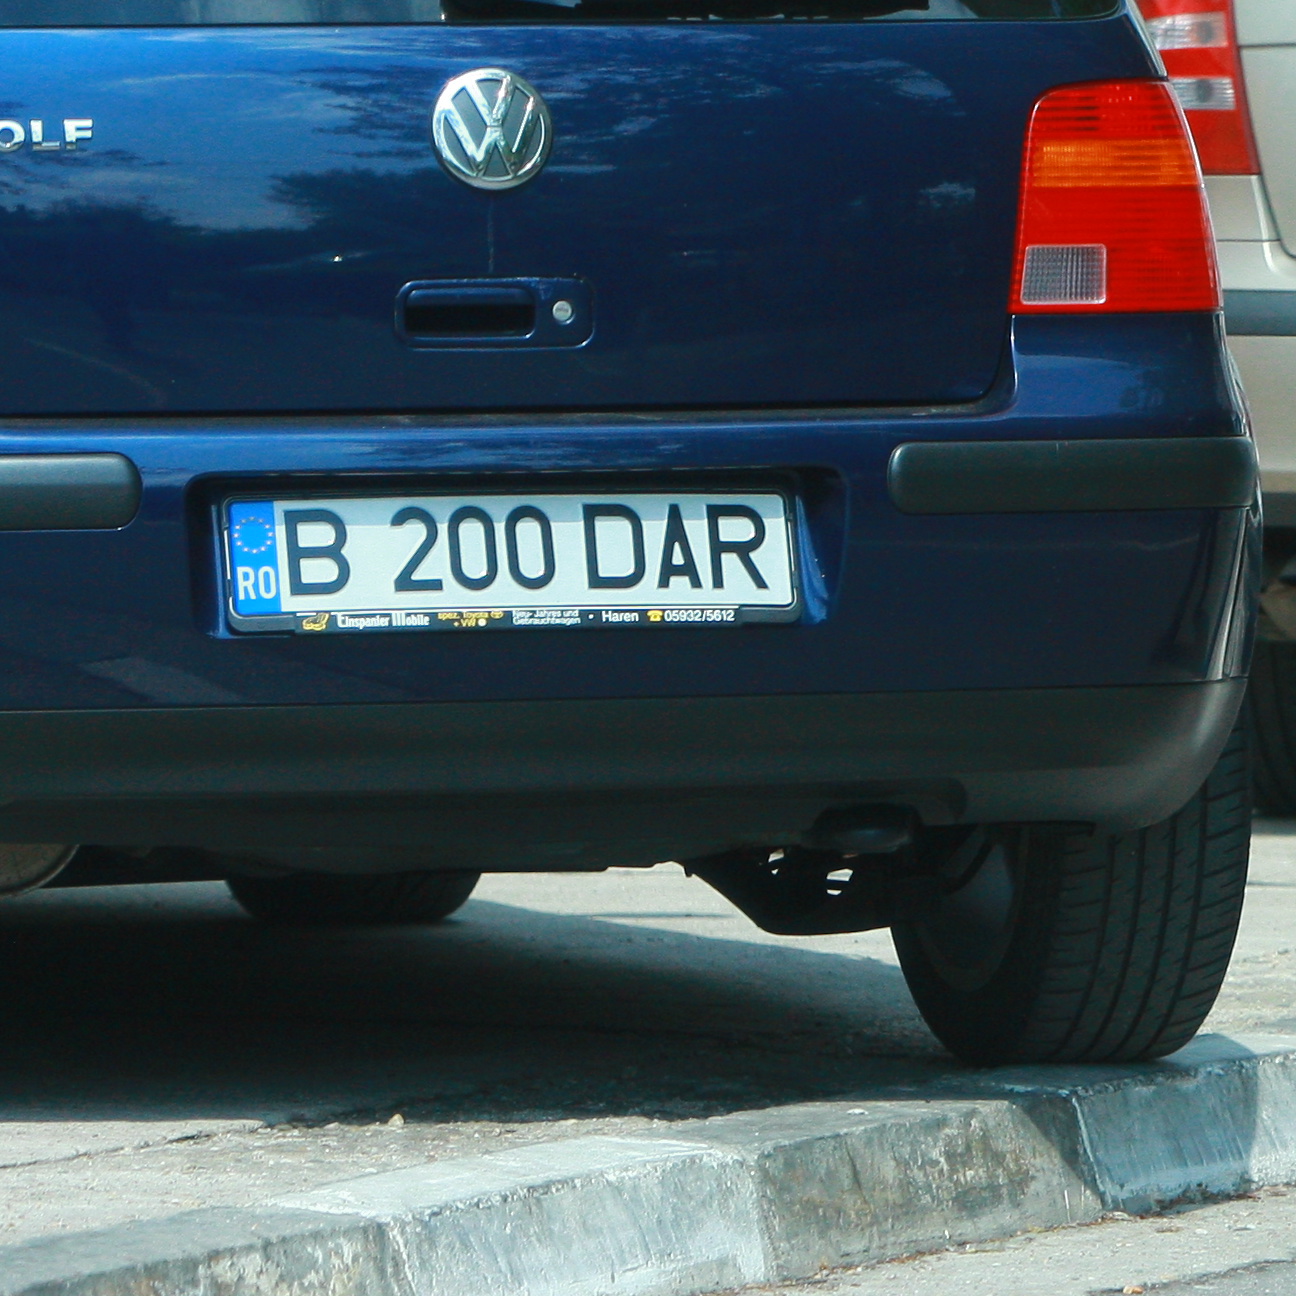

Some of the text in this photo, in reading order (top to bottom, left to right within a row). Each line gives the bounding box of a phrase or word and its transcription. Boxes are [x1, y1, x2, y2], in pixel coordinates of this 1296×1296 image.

[284, 503, 770, 596] B 200 DAR
[237, 565, 277, 600] RO
[601, 610, 640, 623] Haren
[664, 609, 735, 622] 05932/5612
